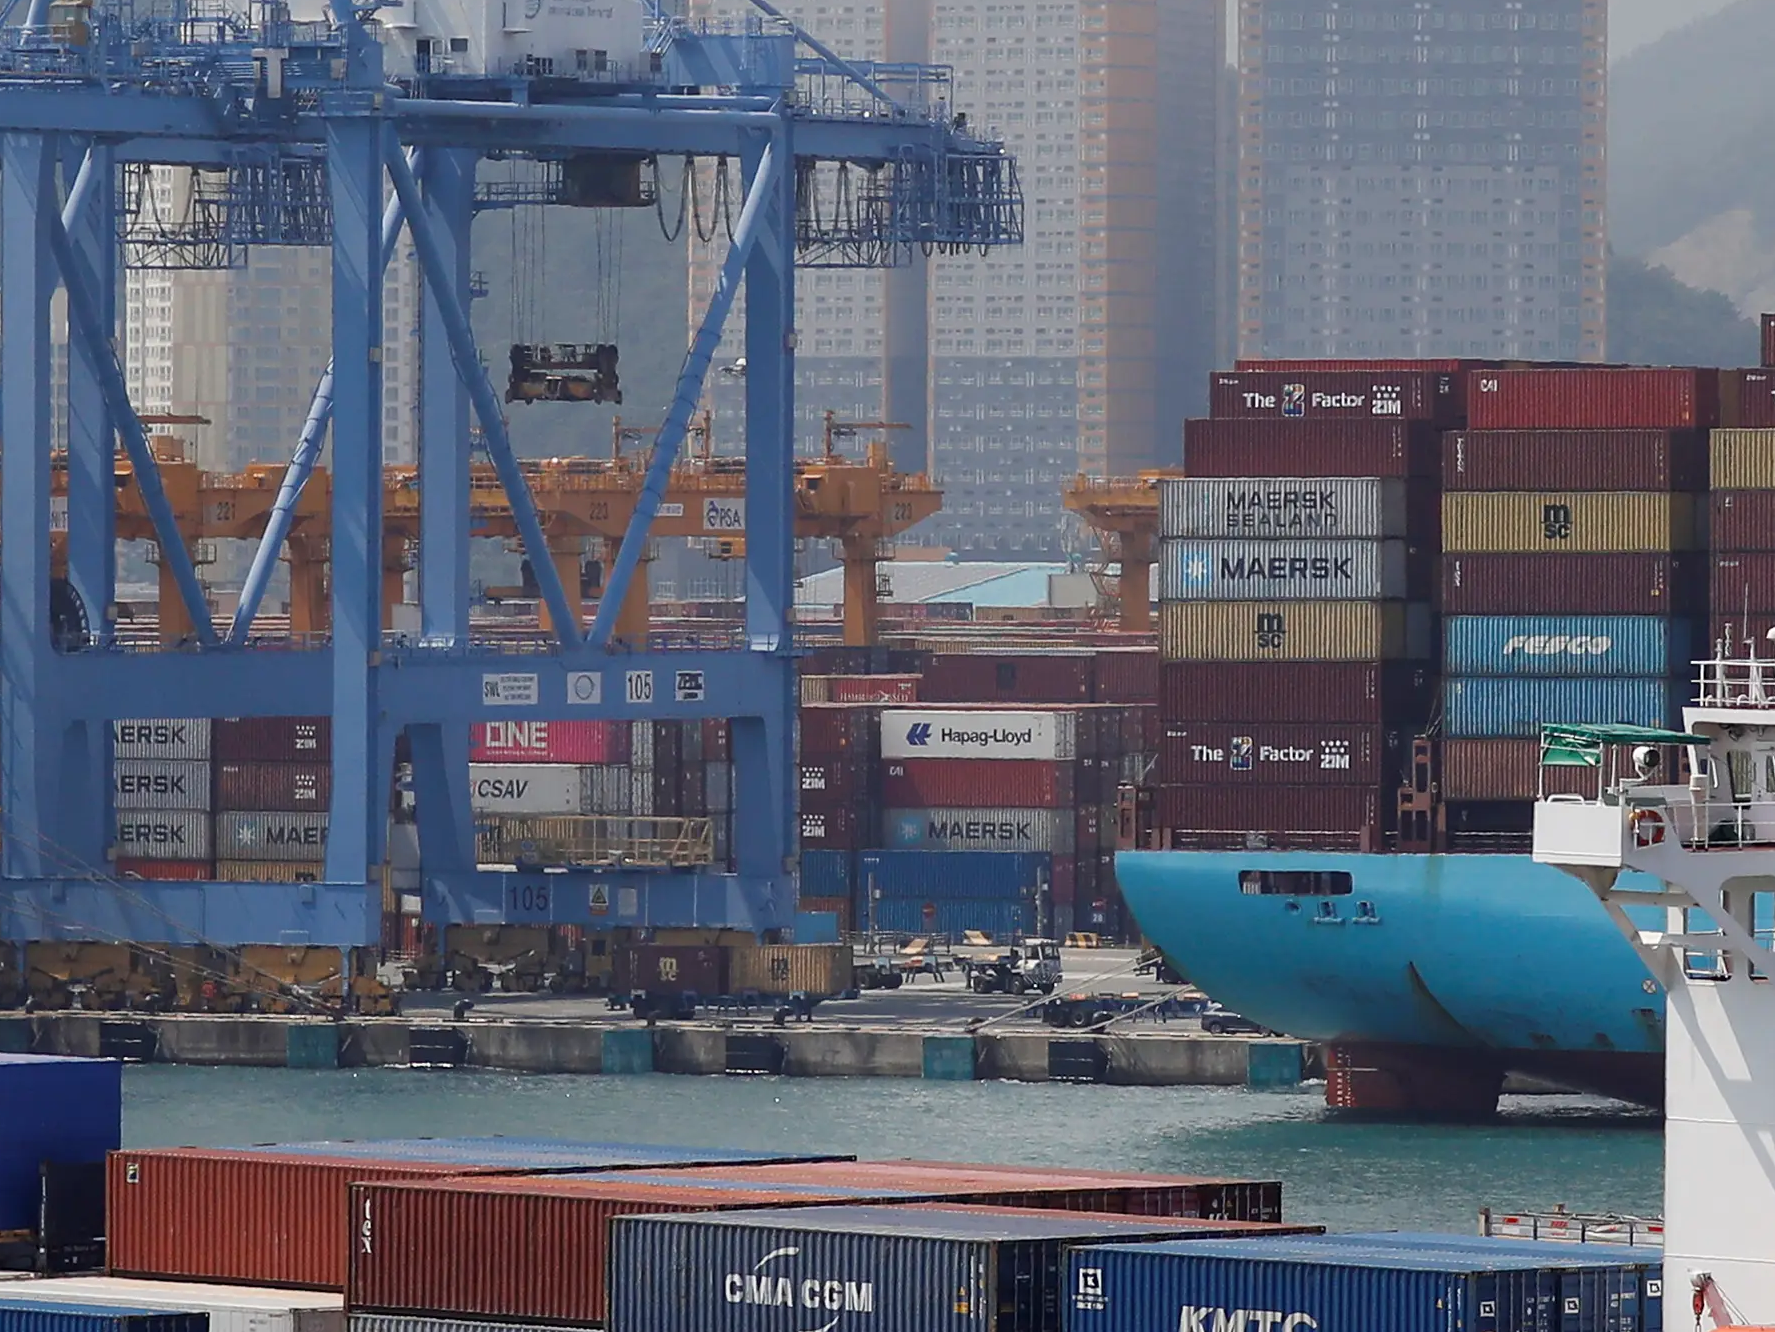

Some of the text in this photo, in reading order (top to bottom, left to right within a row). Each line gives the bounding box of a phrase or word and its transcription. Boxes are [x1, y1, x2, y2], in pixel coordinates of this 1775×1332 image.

[1242, 392, 1365, 408] The Factor
[1227, 491, 1335, 509] MAERSK
[589, 502, 609, 520] 223
[719, 508, 741, 528] PSA
[1227, 514, 1336, 528] SEALAND
[1221, 558, 1352, 579] MAERSK
[627, 674, 651, 701] 105
[486, 721, 549, 748] ONE
[941, 728, 1032, 746] Hapag-Lloyd
[1191, 745, 1313, 761] The Factor
[478, 779, 529, 799] CSAV
[928, 822, 1032, 840] MAERSK
[509, 885, 548, 911] 105
[724, 1273, 873, 1313] CMA CGM
